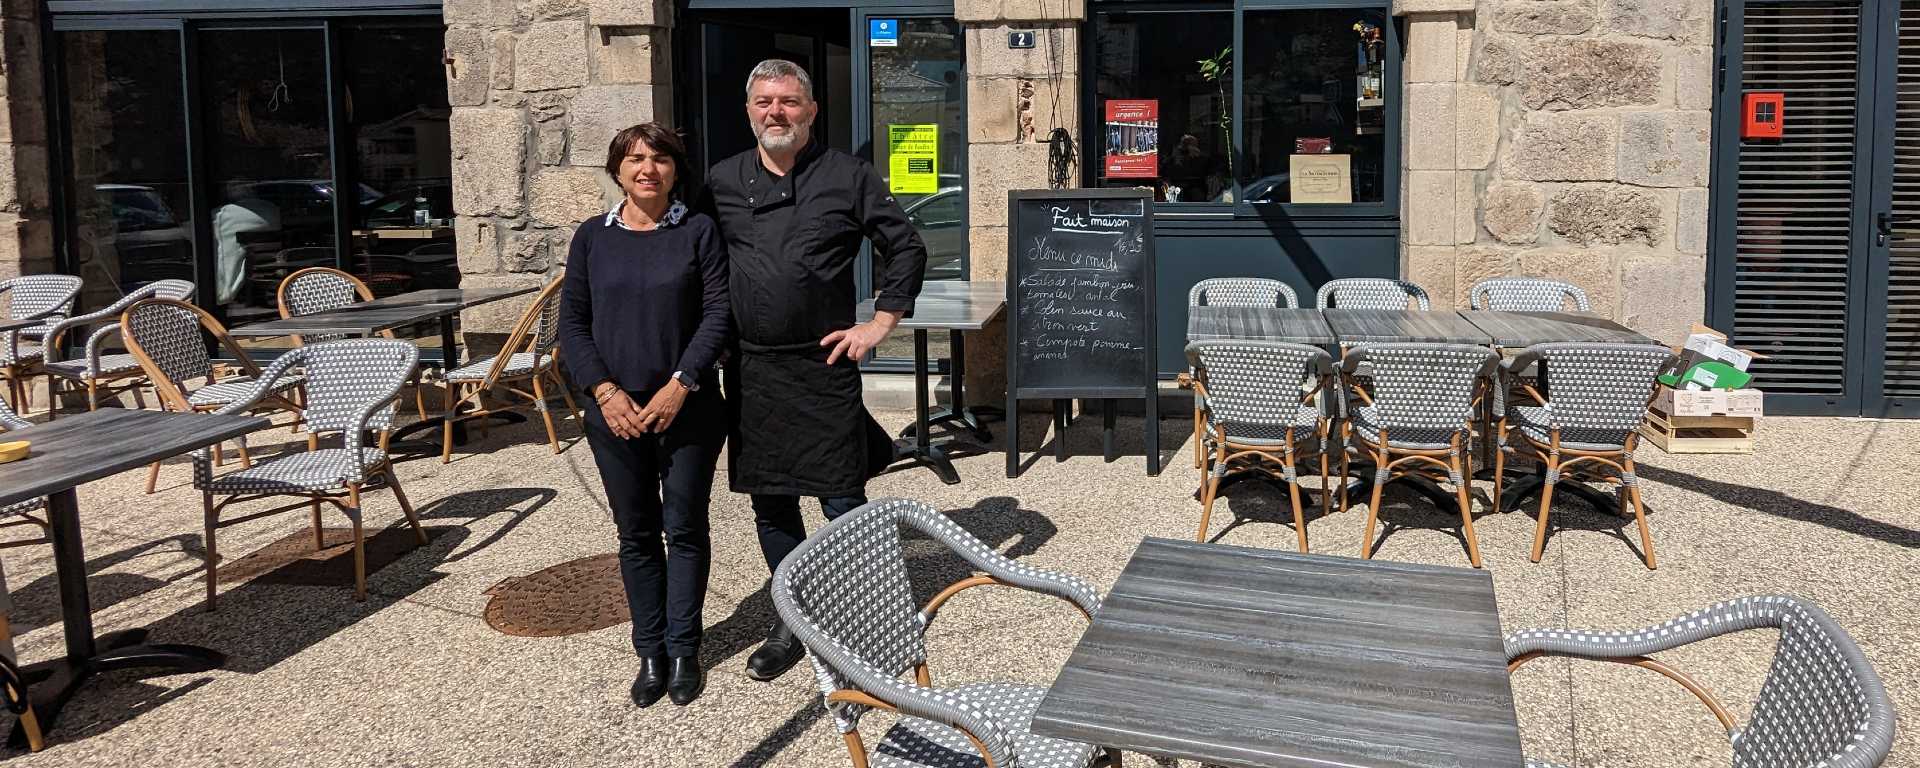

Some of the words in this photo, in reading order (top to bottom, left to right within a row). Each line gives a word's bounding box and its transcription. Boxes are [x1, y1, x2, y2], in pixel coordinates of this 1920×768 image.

[1018, 33, 1025, 46] 2
[1051, 205, 1088, 228] Fait
[1090, 217, 1130, 228] maison
[1028, 236, 1066, 262] Menu
[1085, 250, 1120, 273] midi
